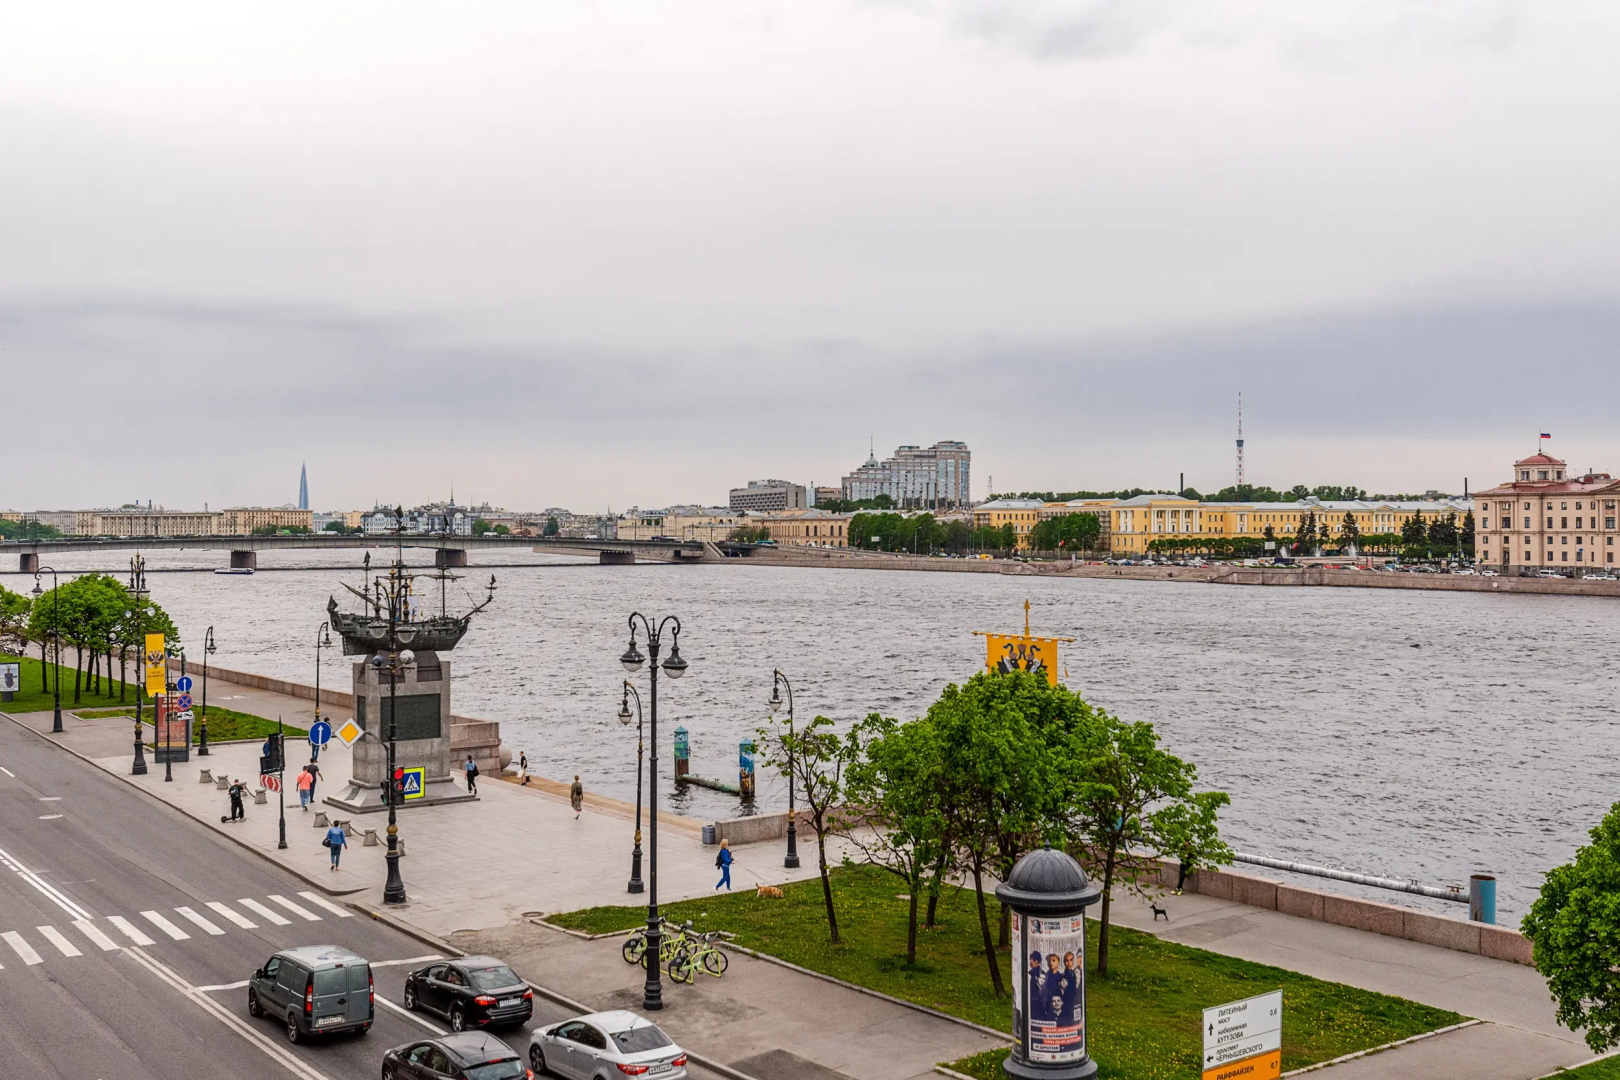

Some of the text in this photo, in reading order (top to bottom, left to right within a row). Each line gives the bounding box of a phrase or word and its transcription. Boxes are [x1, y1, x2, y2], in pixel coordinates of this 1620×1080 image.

[1218, 1003, 1247, 1017] ЛИТЕЙНЫЙ
[1270, 1008, 1278, 1016] 0,6
[1218, 1023, 1247, 1036] набережная
[1217, 1031, 1243, 1044] КУТУЗОВА
[1216, 1044, 1238, 1055] проспект
[1216, 1043, 1263, 1062] ЧЕРНЫШЕВСКОГО
